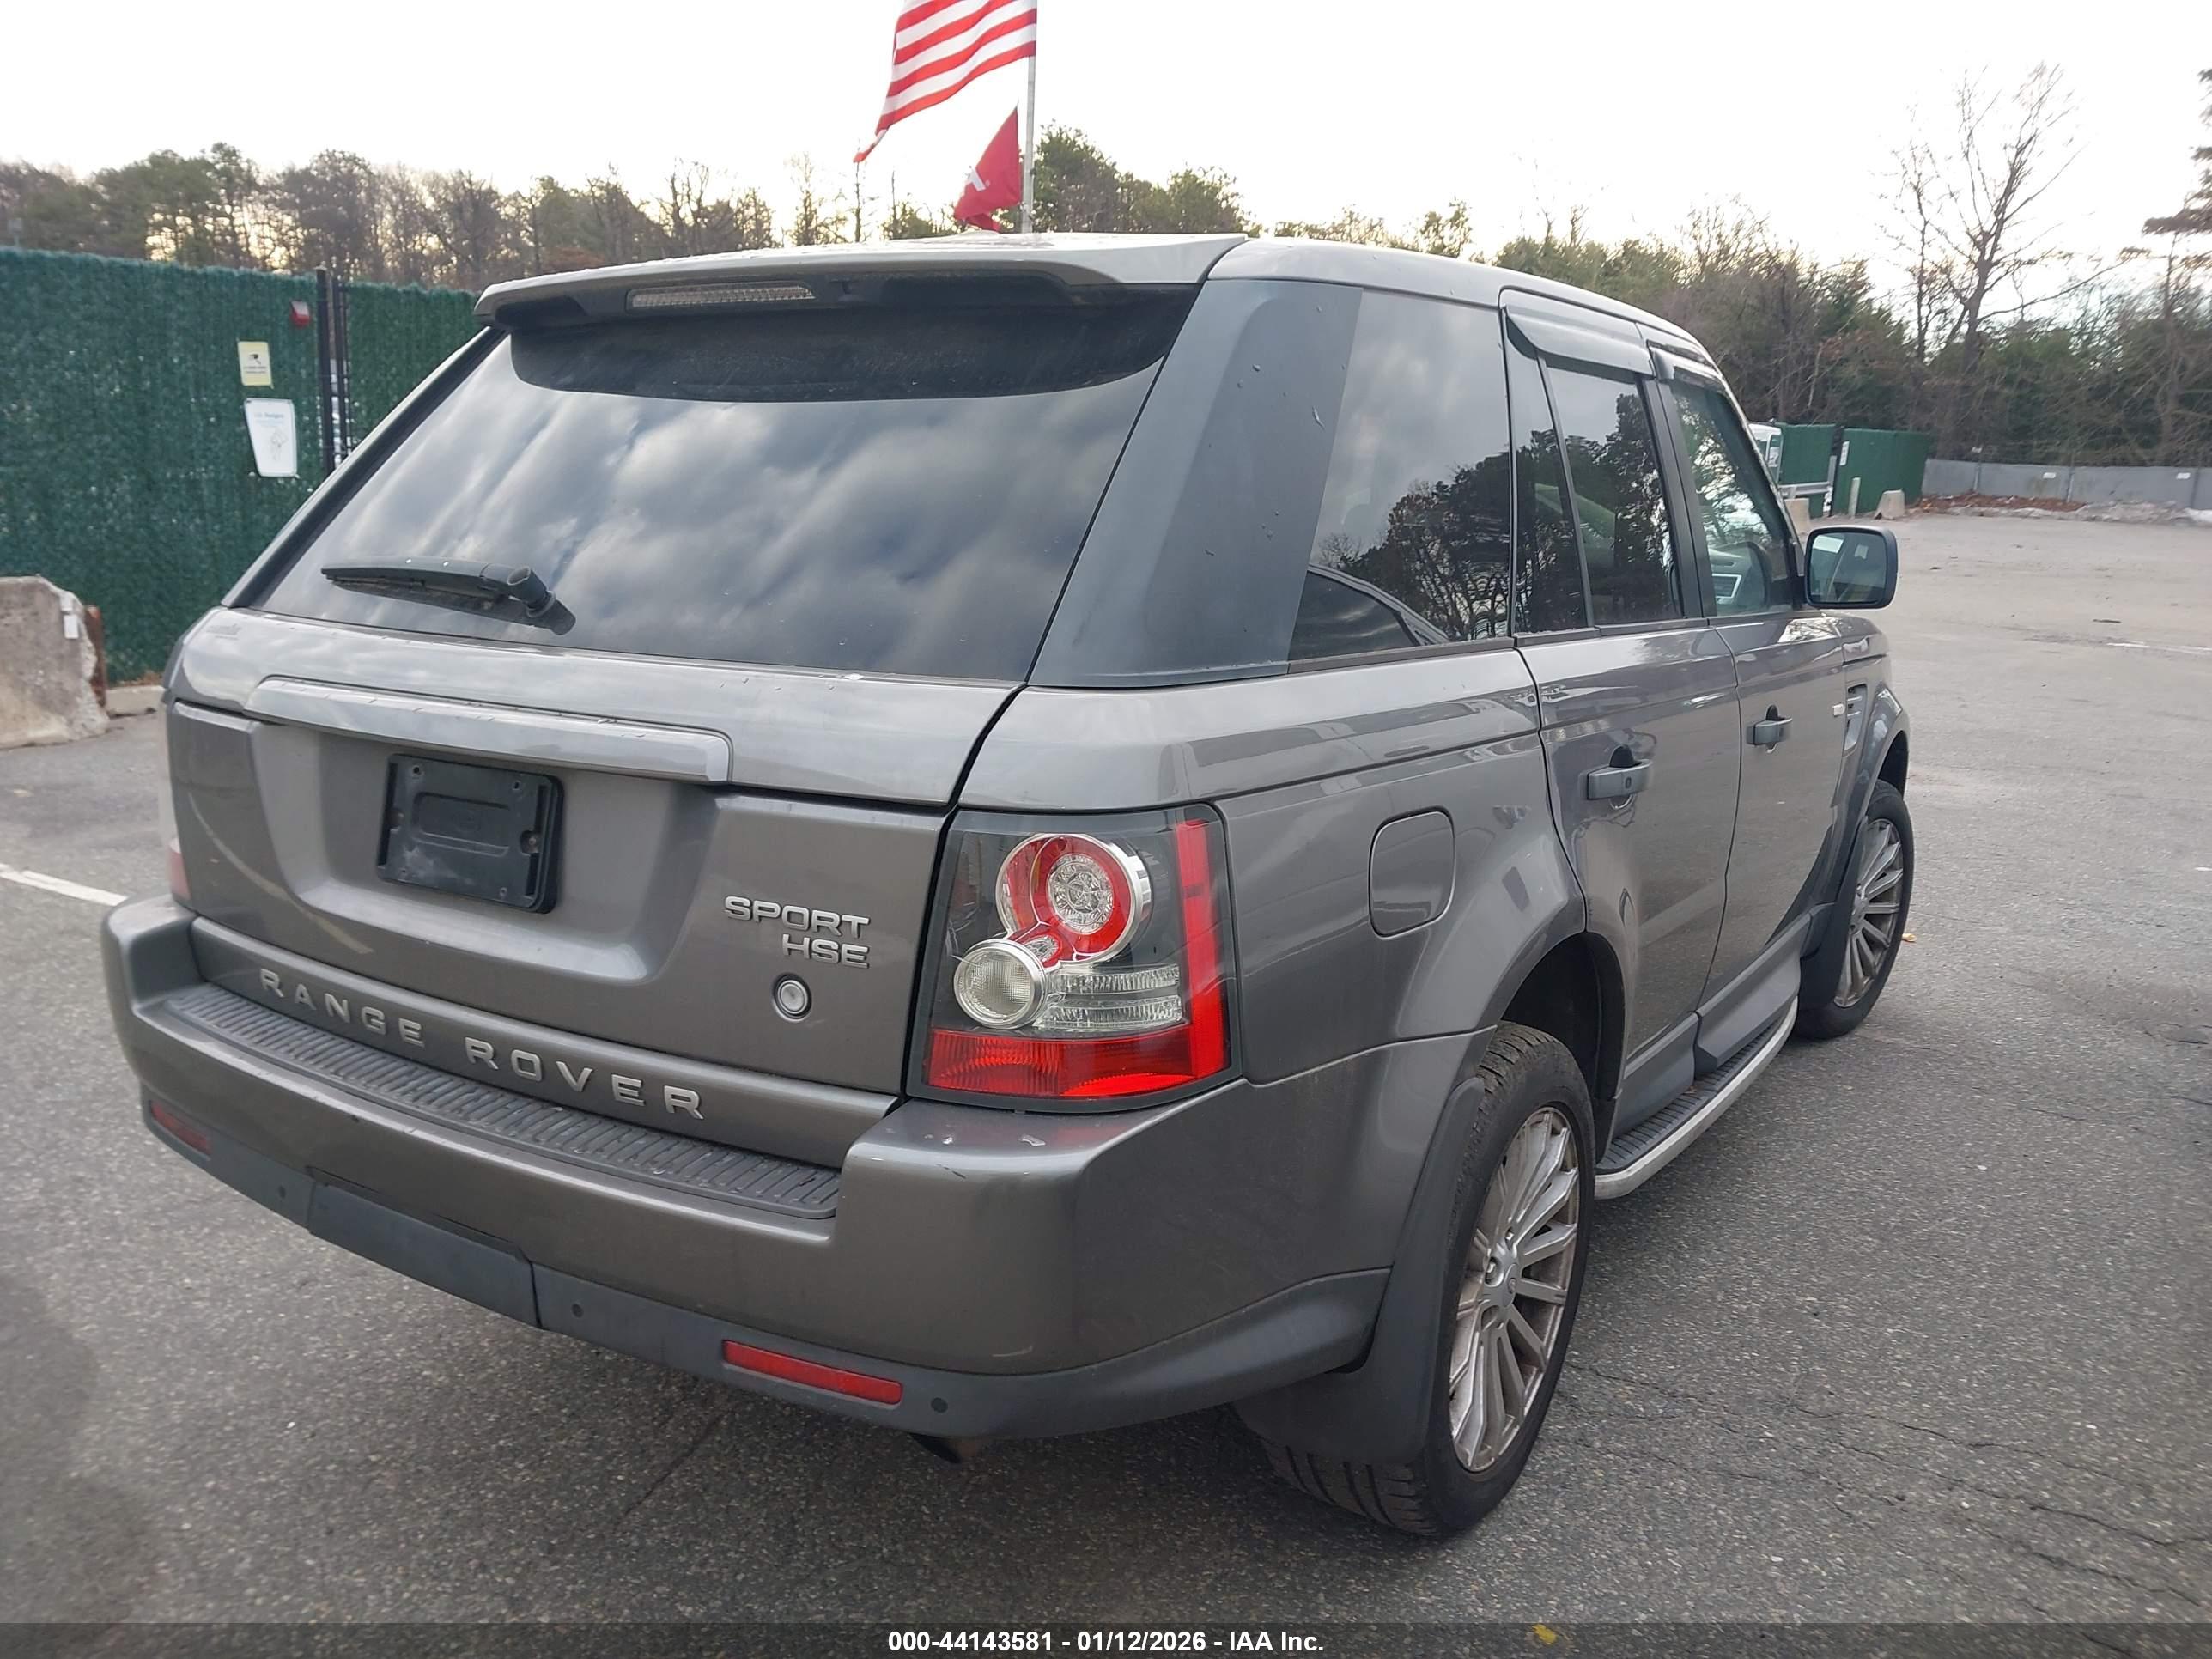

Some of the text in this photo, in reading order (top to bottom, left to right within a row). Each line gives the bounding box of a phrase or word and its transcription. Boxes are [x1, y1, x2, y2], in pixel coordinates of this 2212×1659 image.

[724, 895, 871, 939] SPORT
[781, 933, 870, 969] HSE
[260, 967, 704, 1120] RANGE ROVER
